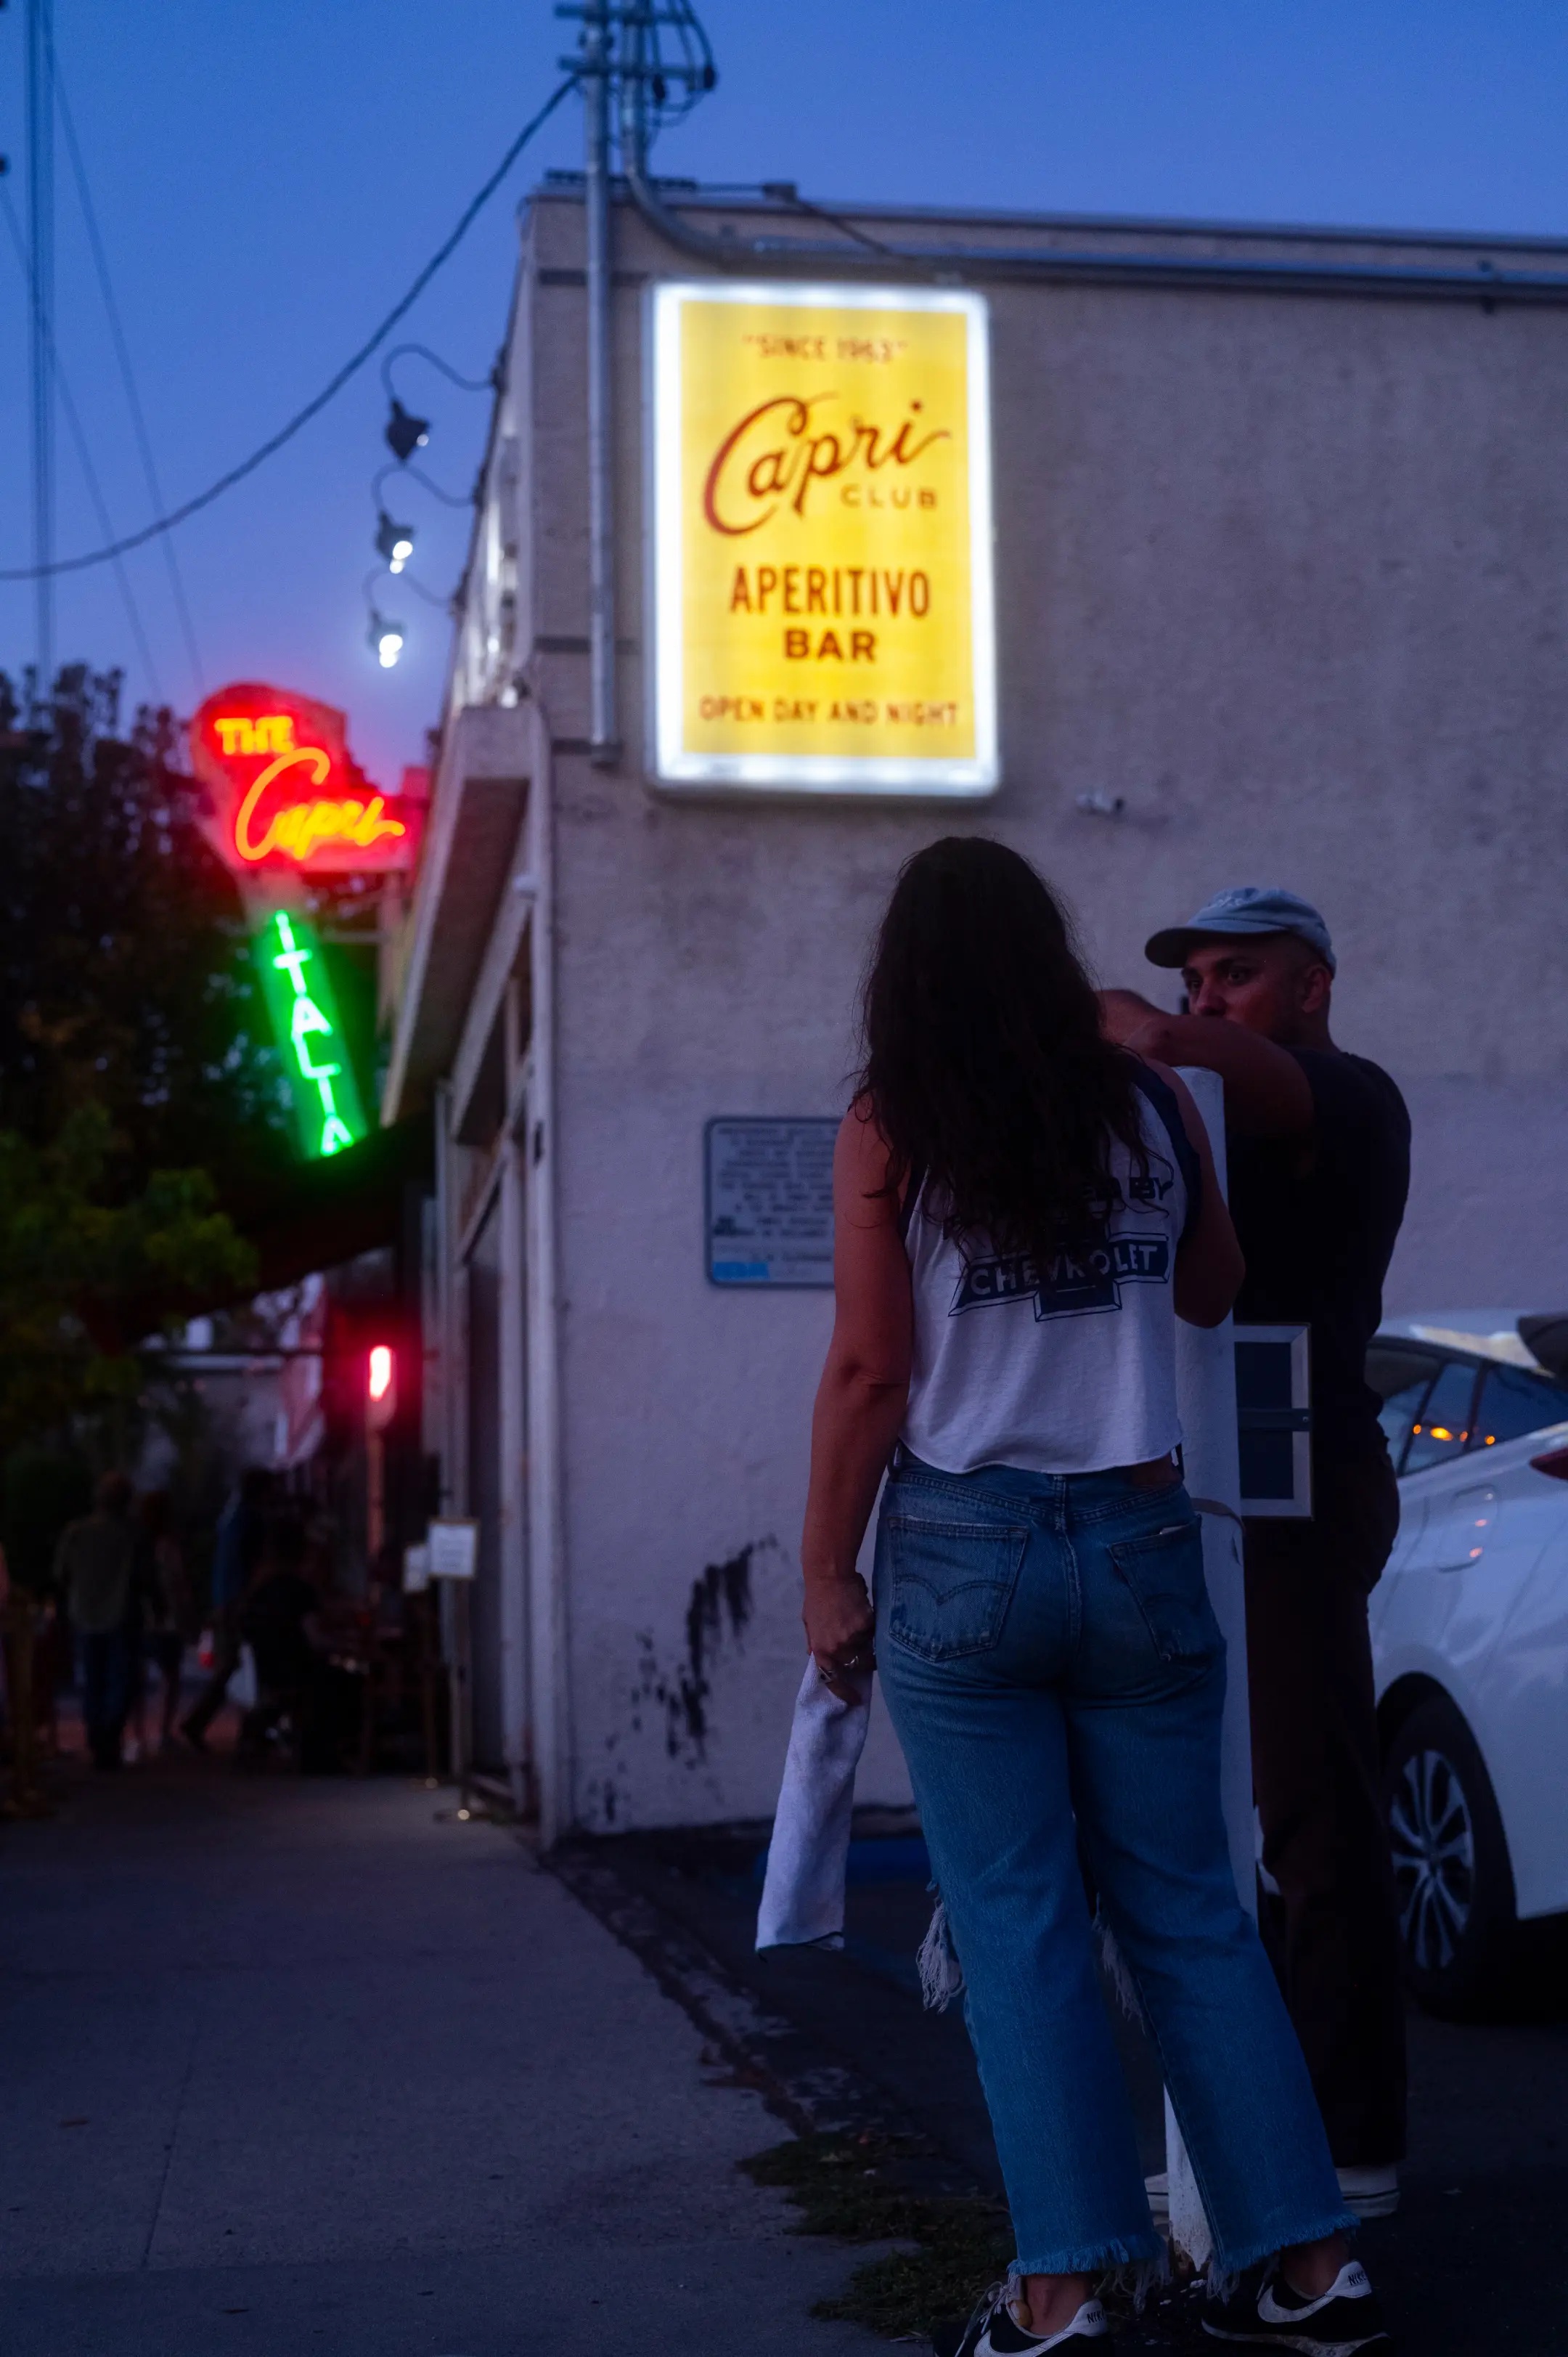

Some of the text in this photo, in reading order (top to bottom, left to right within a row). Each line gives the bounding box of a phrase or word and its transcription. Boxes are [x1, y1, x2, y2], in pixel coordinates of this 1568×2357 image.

[703, 396, 951, 536] Capri
[840, 484, 938, 510] CLUB
[729, 566, 931, 617] APERITIVO
[783, 628, 878, 663] BAR
[699, 695, 958, 727] OPEN DAY AND NIGHT
[213, 715, 295, 755] THE
[272, 909, 354, 1157] ITALIA
